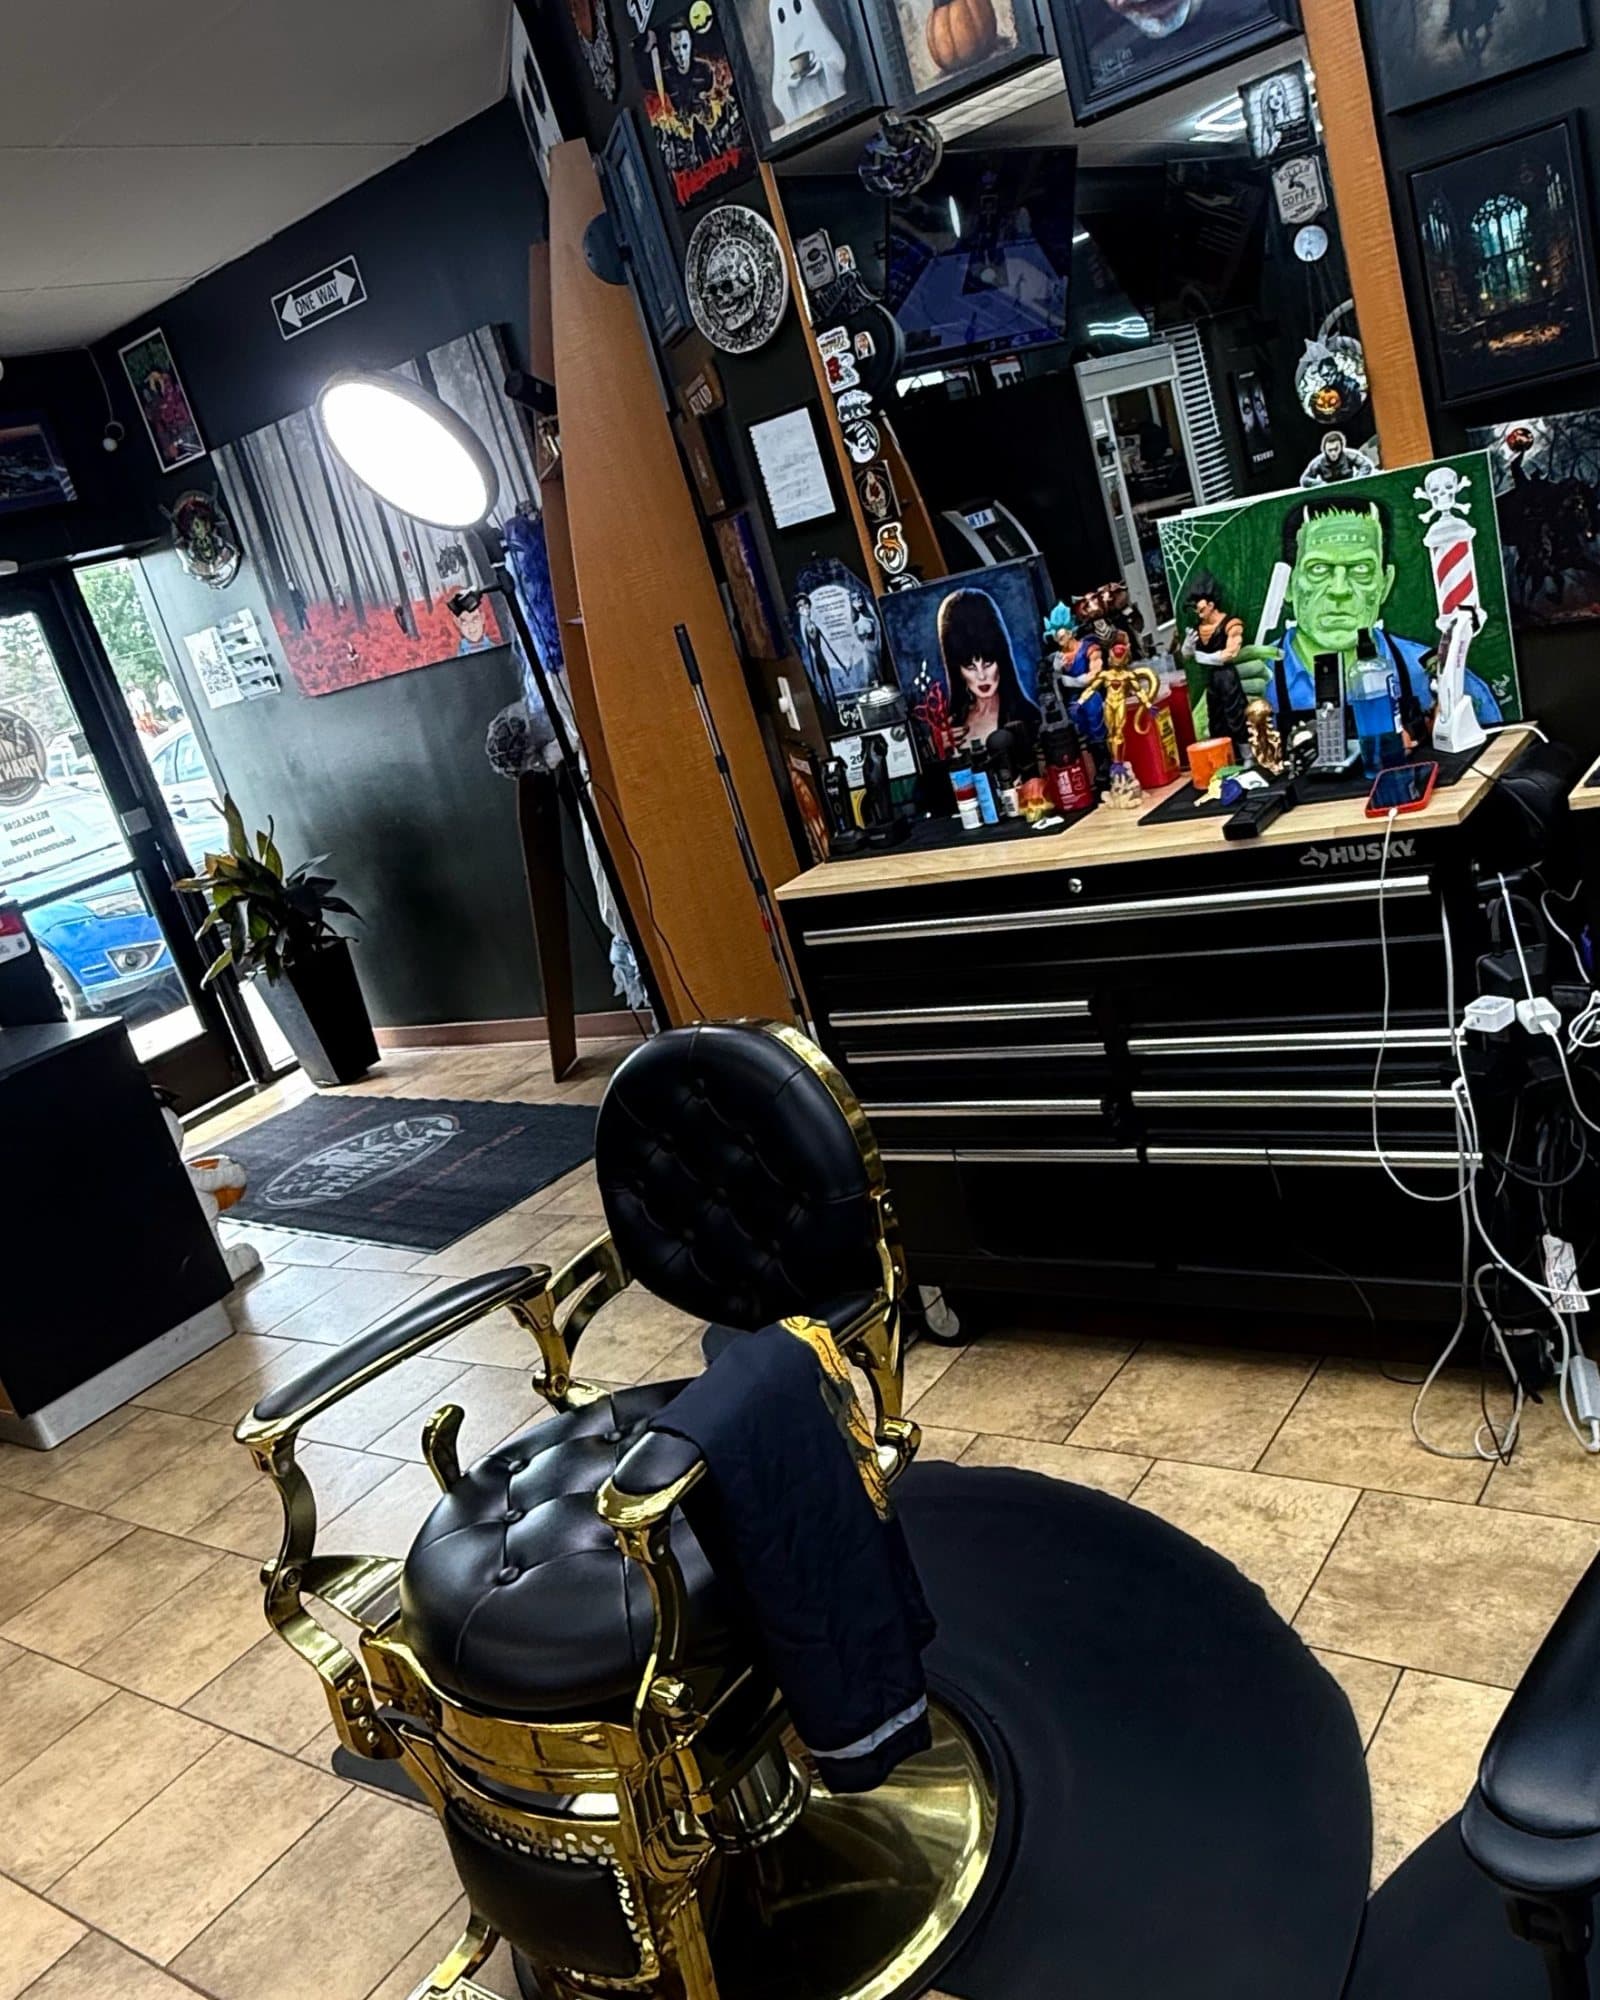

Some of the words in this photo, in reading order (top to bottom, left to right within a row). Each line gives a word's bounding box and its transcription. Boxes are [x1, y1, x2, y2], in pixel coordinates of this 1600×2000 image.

[1282, 187, 1316, 207] COFFEE
[294, 295, 316, 316] ONE
[316, 281, 338, 304] WAY
[1331, 839, 1415, 864] HUSKY
[311, 1128, 465, 1199] PHANTOM
